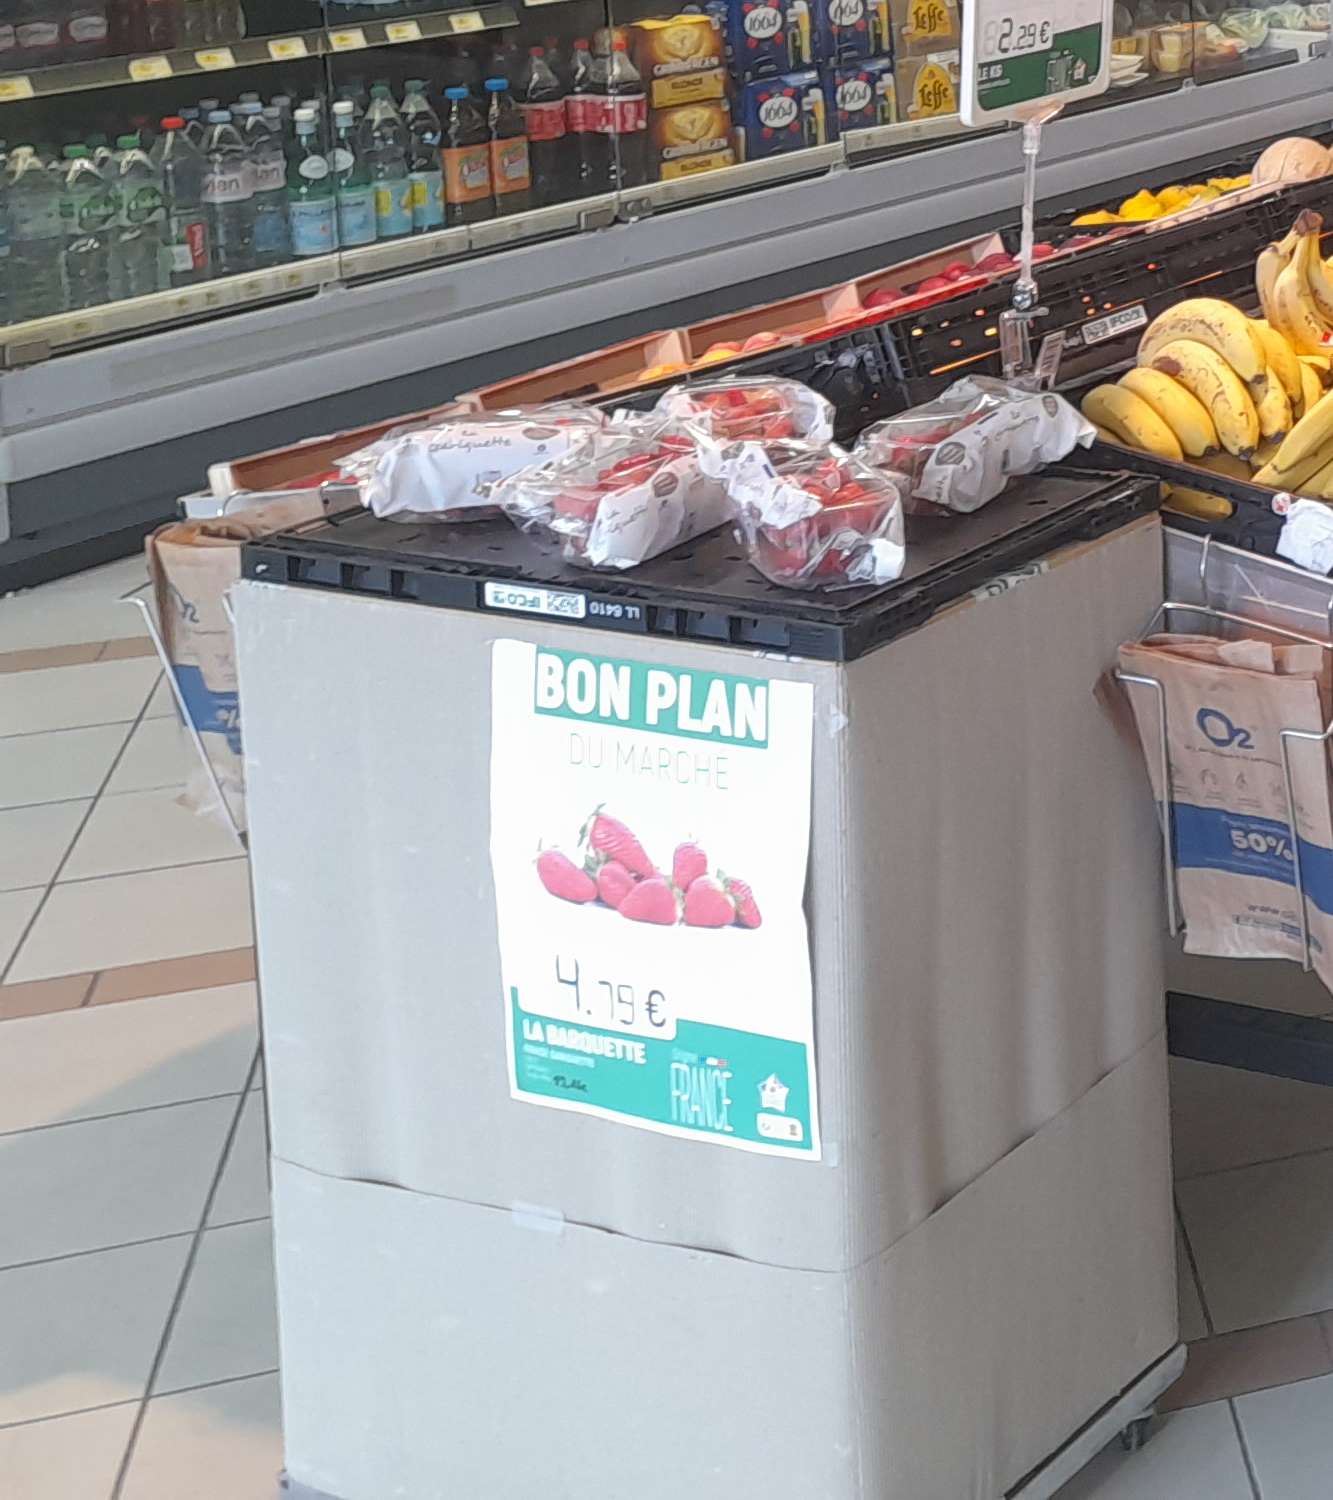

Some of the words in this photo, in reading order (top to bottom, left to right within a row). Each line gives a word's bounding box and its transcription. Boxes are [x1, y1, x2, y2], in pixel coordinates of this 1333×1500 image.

[913, 5, 944, 33] Leffe
[919, 80, 949, 110] Leffe
[589, 601, 623, 618] 6410
[536, 651, 631, 722] BON
[646, 669, 769, 742] PLAN
[569, 732, 604, 768] DU
[616, 739, 730, 790] MARCHÉ
[1230, 829, 1294, 861] 50%
[522, 1018, 545, 1042] LA
[546, 1024, 647, 1065] BARQUETTE
[670, 1062, 735, 1132] FRANCE
